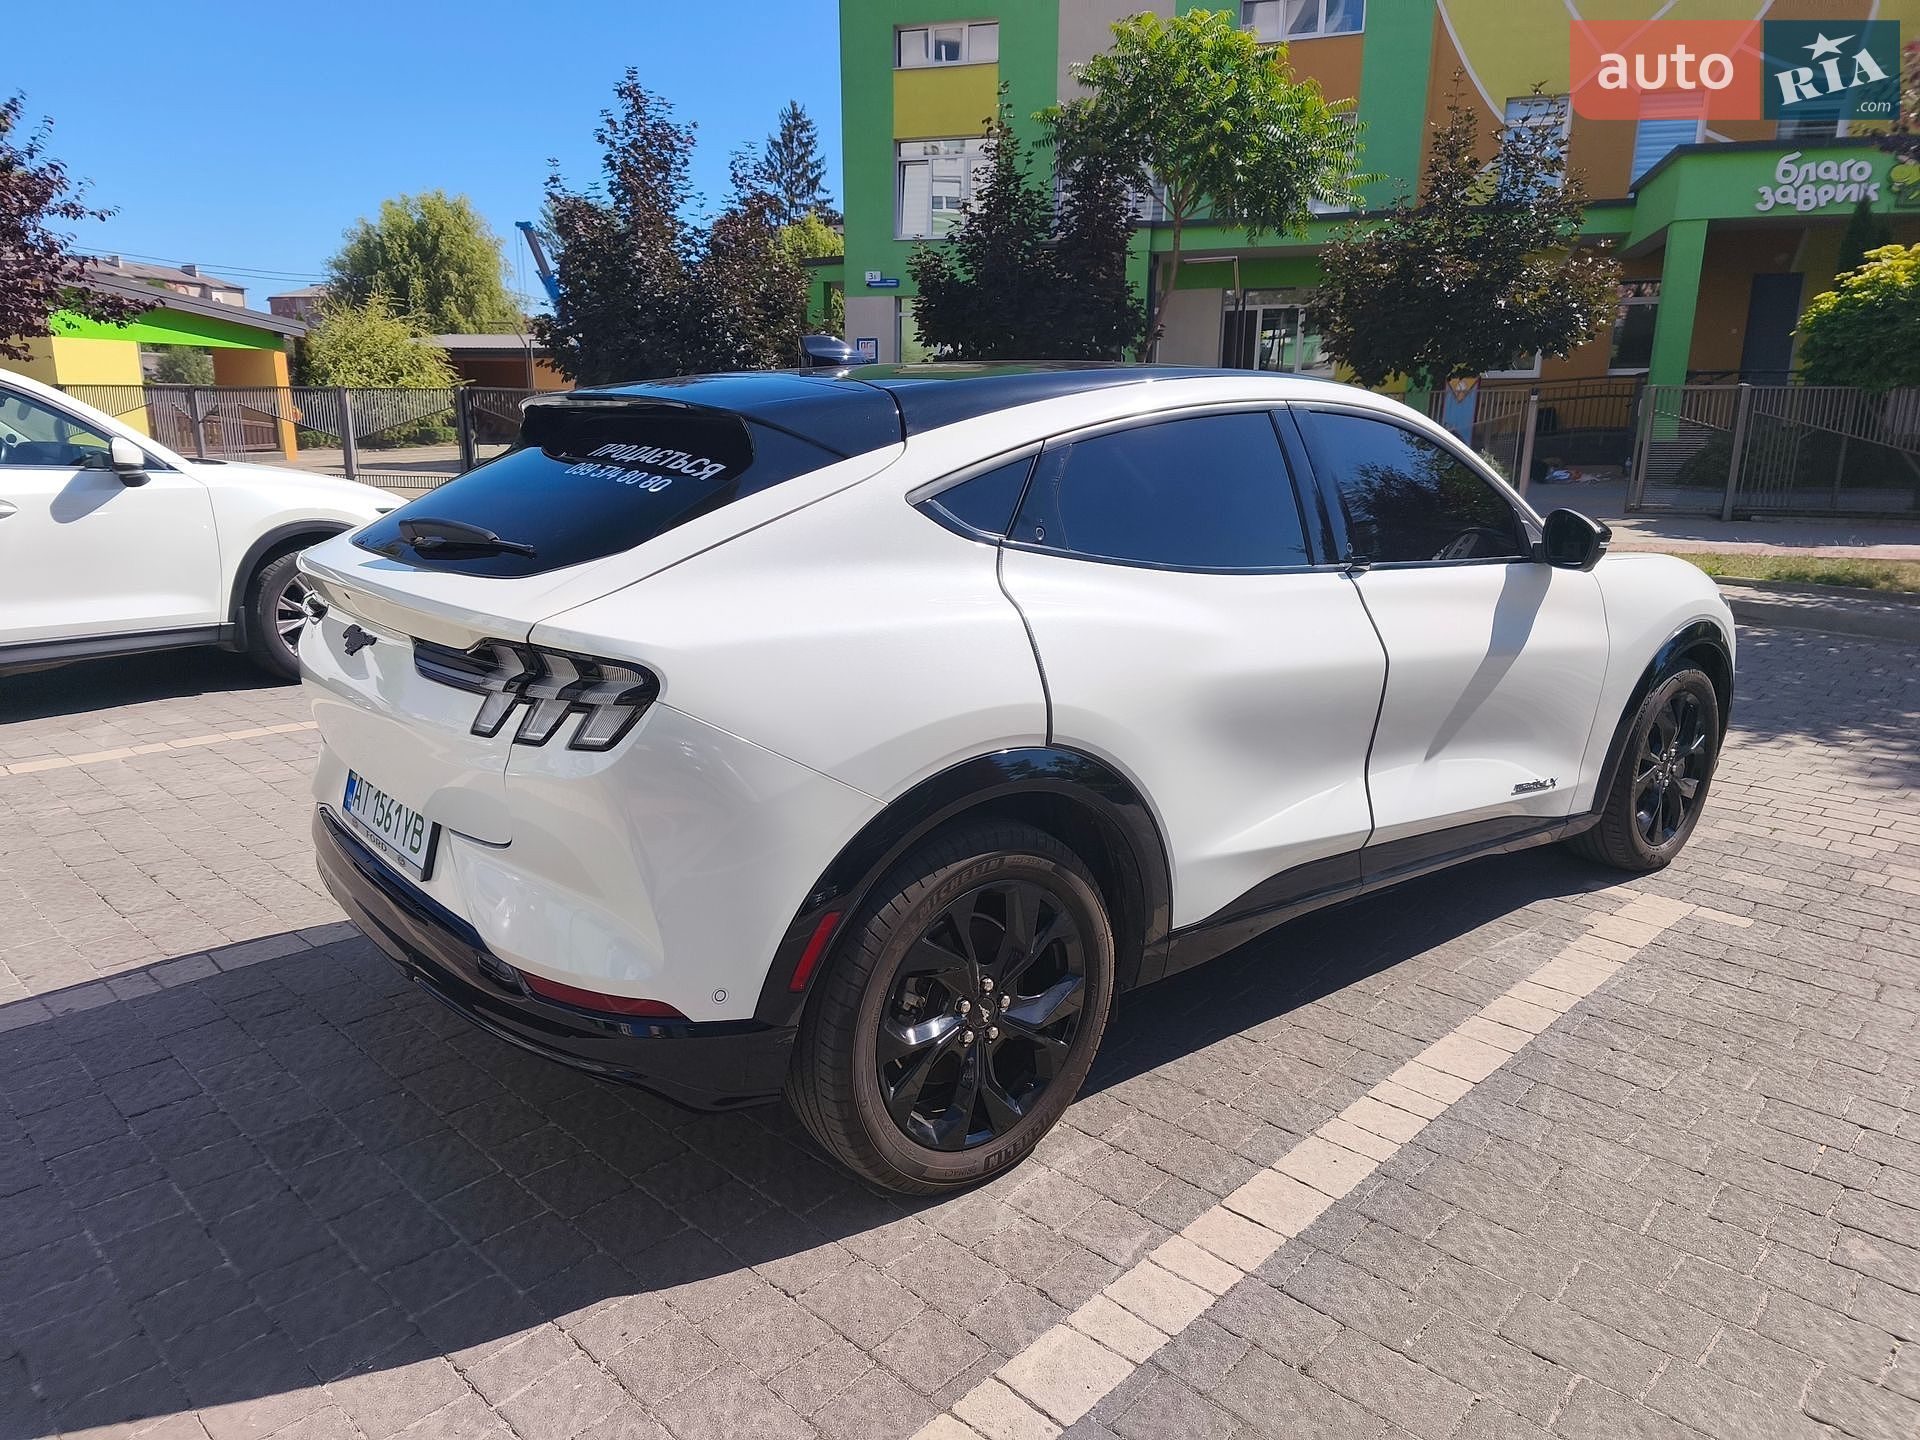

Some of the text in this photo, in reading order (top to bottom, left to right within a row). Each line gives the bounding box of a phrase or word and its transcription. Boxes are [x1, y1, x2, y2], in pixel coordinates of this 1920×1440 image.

[1775, 151, 1872, 186] благо
[1755, 182, 1880, 212] заврик
[616, 470, 645, 485] 80
[638, 475, 673, 493] 80
[373, 790, 404, 840] 1561
